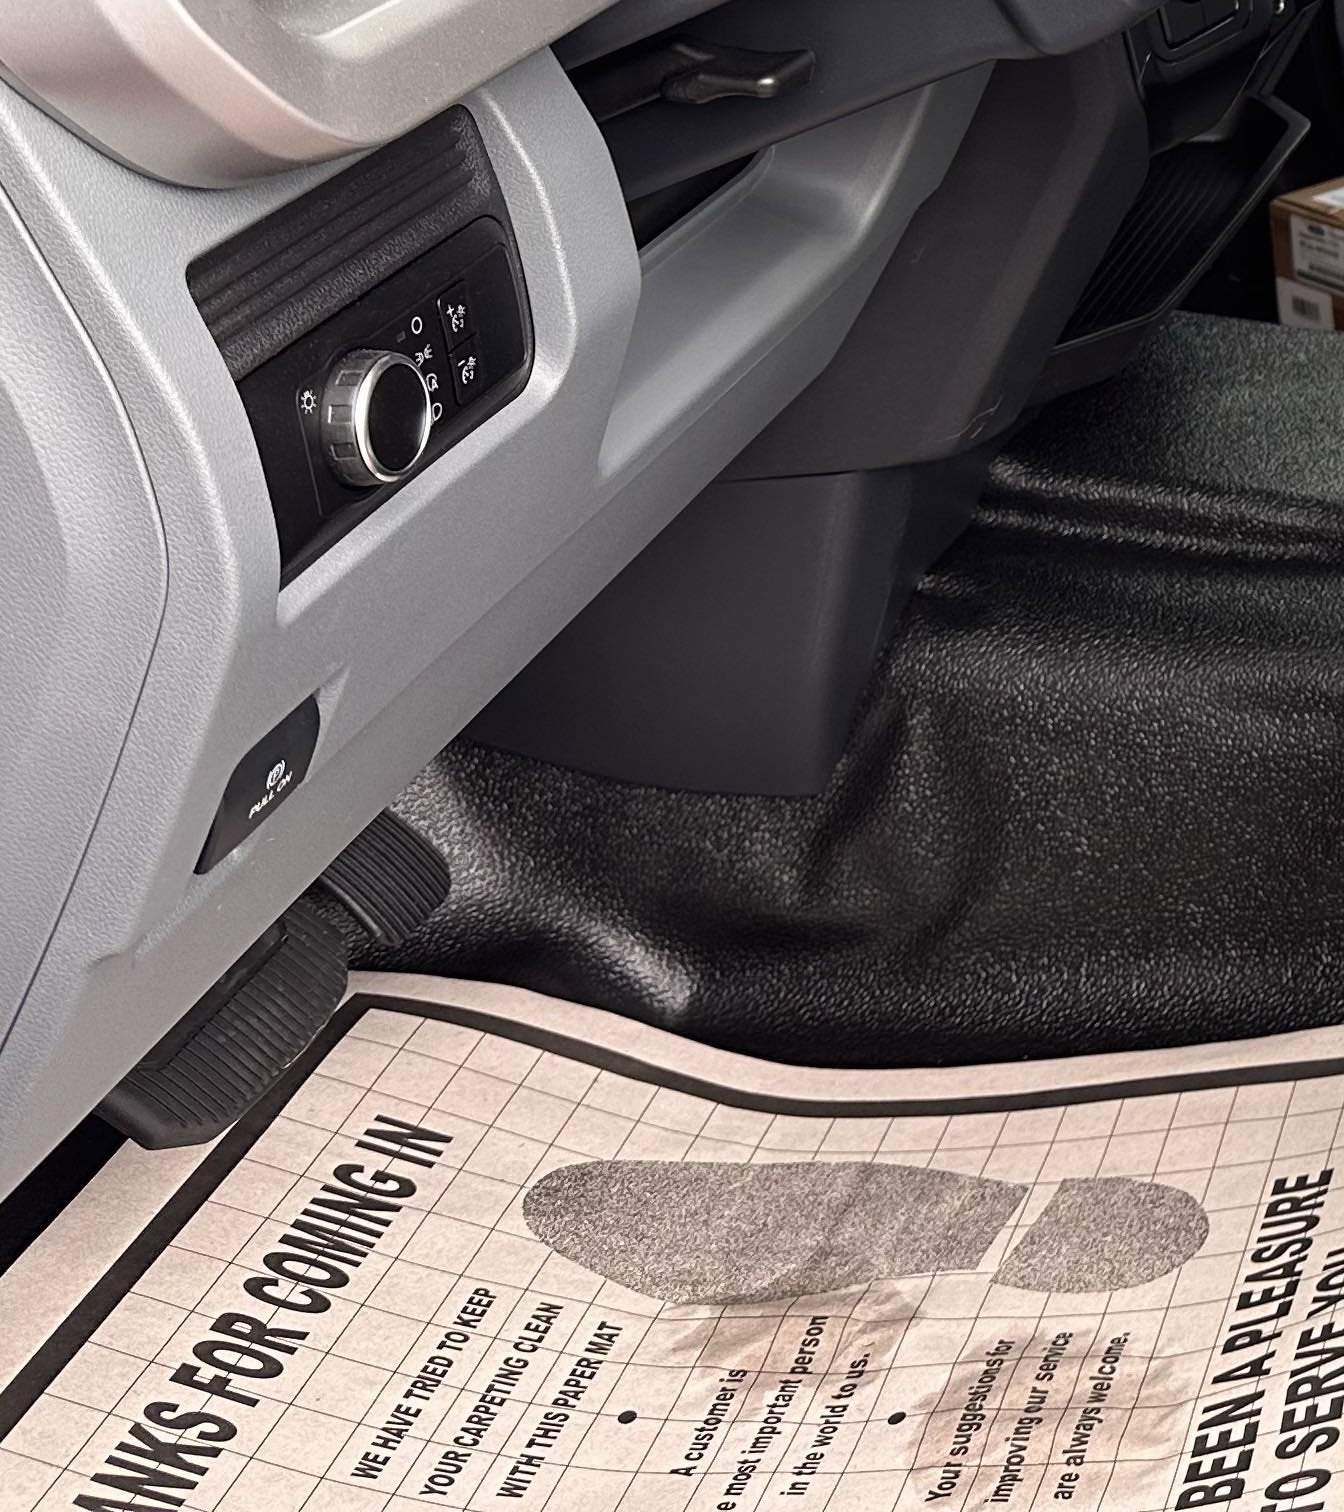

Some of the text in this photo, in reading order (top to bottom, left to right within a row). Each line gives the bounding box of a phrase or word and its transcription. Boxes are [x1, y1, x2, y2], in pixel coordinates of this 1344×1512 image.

[276, 770, 293, 792] ON
[169, 1312, 310, 1407] FOR
[243, 1163, 417, 1314] COMING
[354, 1114, 455, 1169] IN
[1174, 1167, 1335, 1511] BEEN A PLEASURE
[350, 1287, 497, 1480] WE HAVE TRIED TO KEEP
[418, 1301, 565, 1496] YOUR CARPETING CLEAN
[495, 1320, 623, 1498] WITH THIS PAPER MAT
[668, 1369, 748, 1477] A customer is
[740, 1378, 803, 1454] important
[779, 1352, 871, 1496] in the world to us.
[789, 1316, 830, 1375] person
[924, 1338, 1017, 1502] Your suggestions for
[983, 1331, 1074, 1503] improving our service
[1053, 1331, 1131, 1500] are always welcome.
[723, 1458, 762, 1496] most
